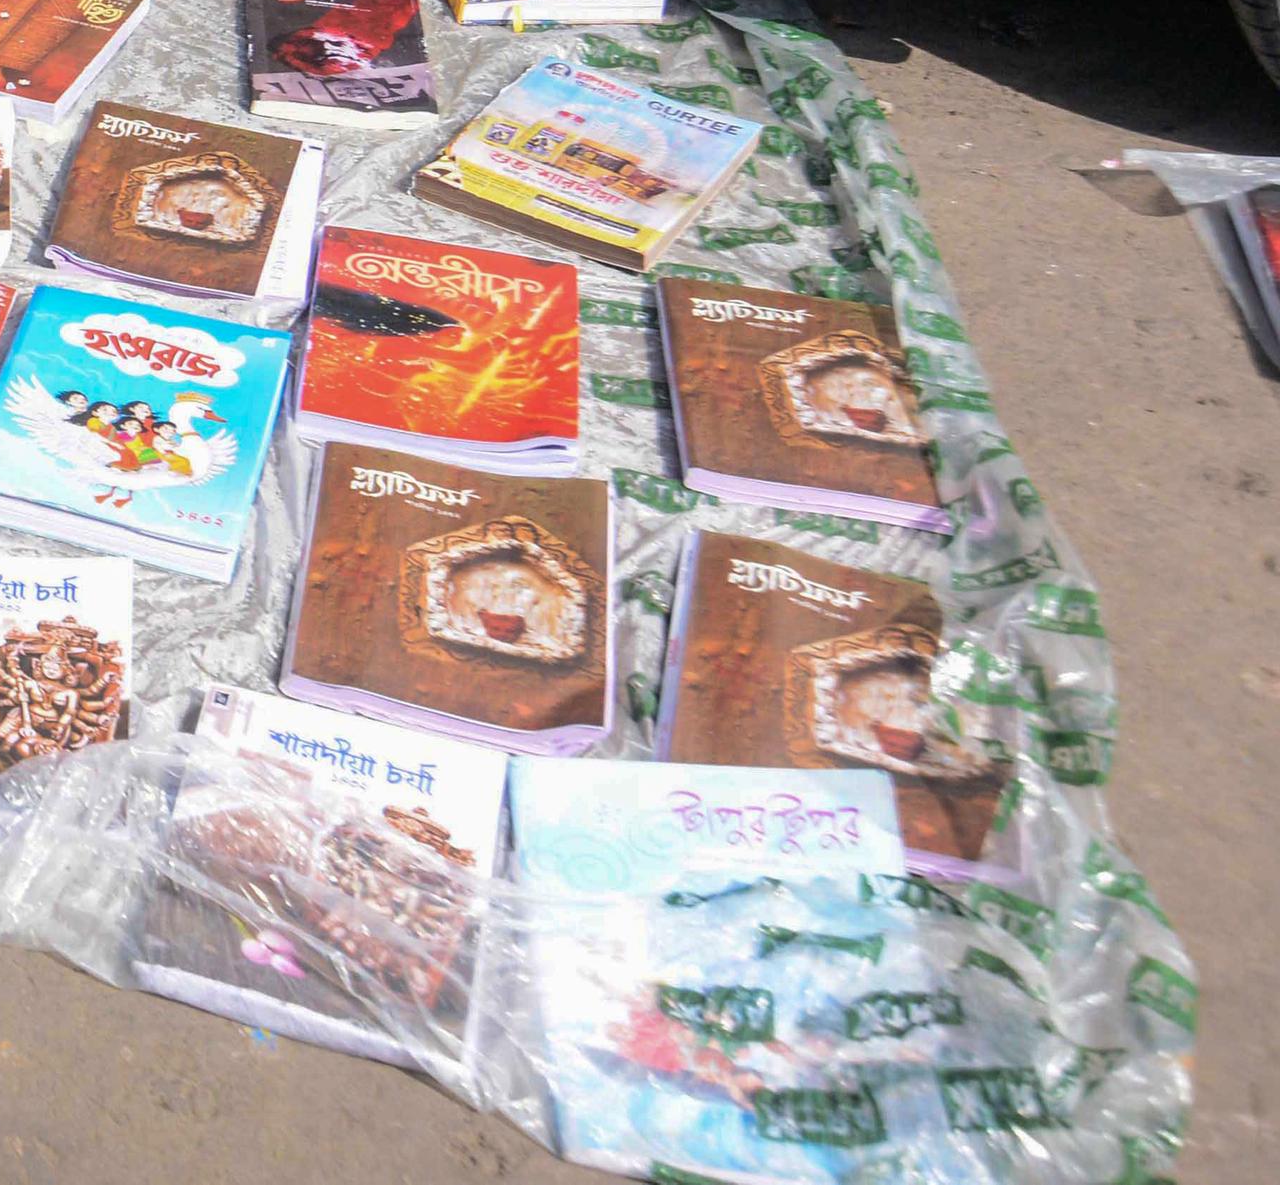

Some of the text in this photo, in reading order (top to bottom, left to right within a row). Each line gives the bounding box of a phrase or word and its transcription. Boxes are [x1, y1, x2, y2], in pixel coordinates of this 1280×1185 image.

[648, 99, 743, 136] GURTEE
[343, 250, 545, 314] অন্তরীপ
[350, 466, 481, 507] প্ল্যাটফর্ম
[35, 575, 80, 603] চর্যা
[268, 726, 435, 796] শারদীয়া চর্যা
[668, 792, 864, 855] টাপুর টুপুর
